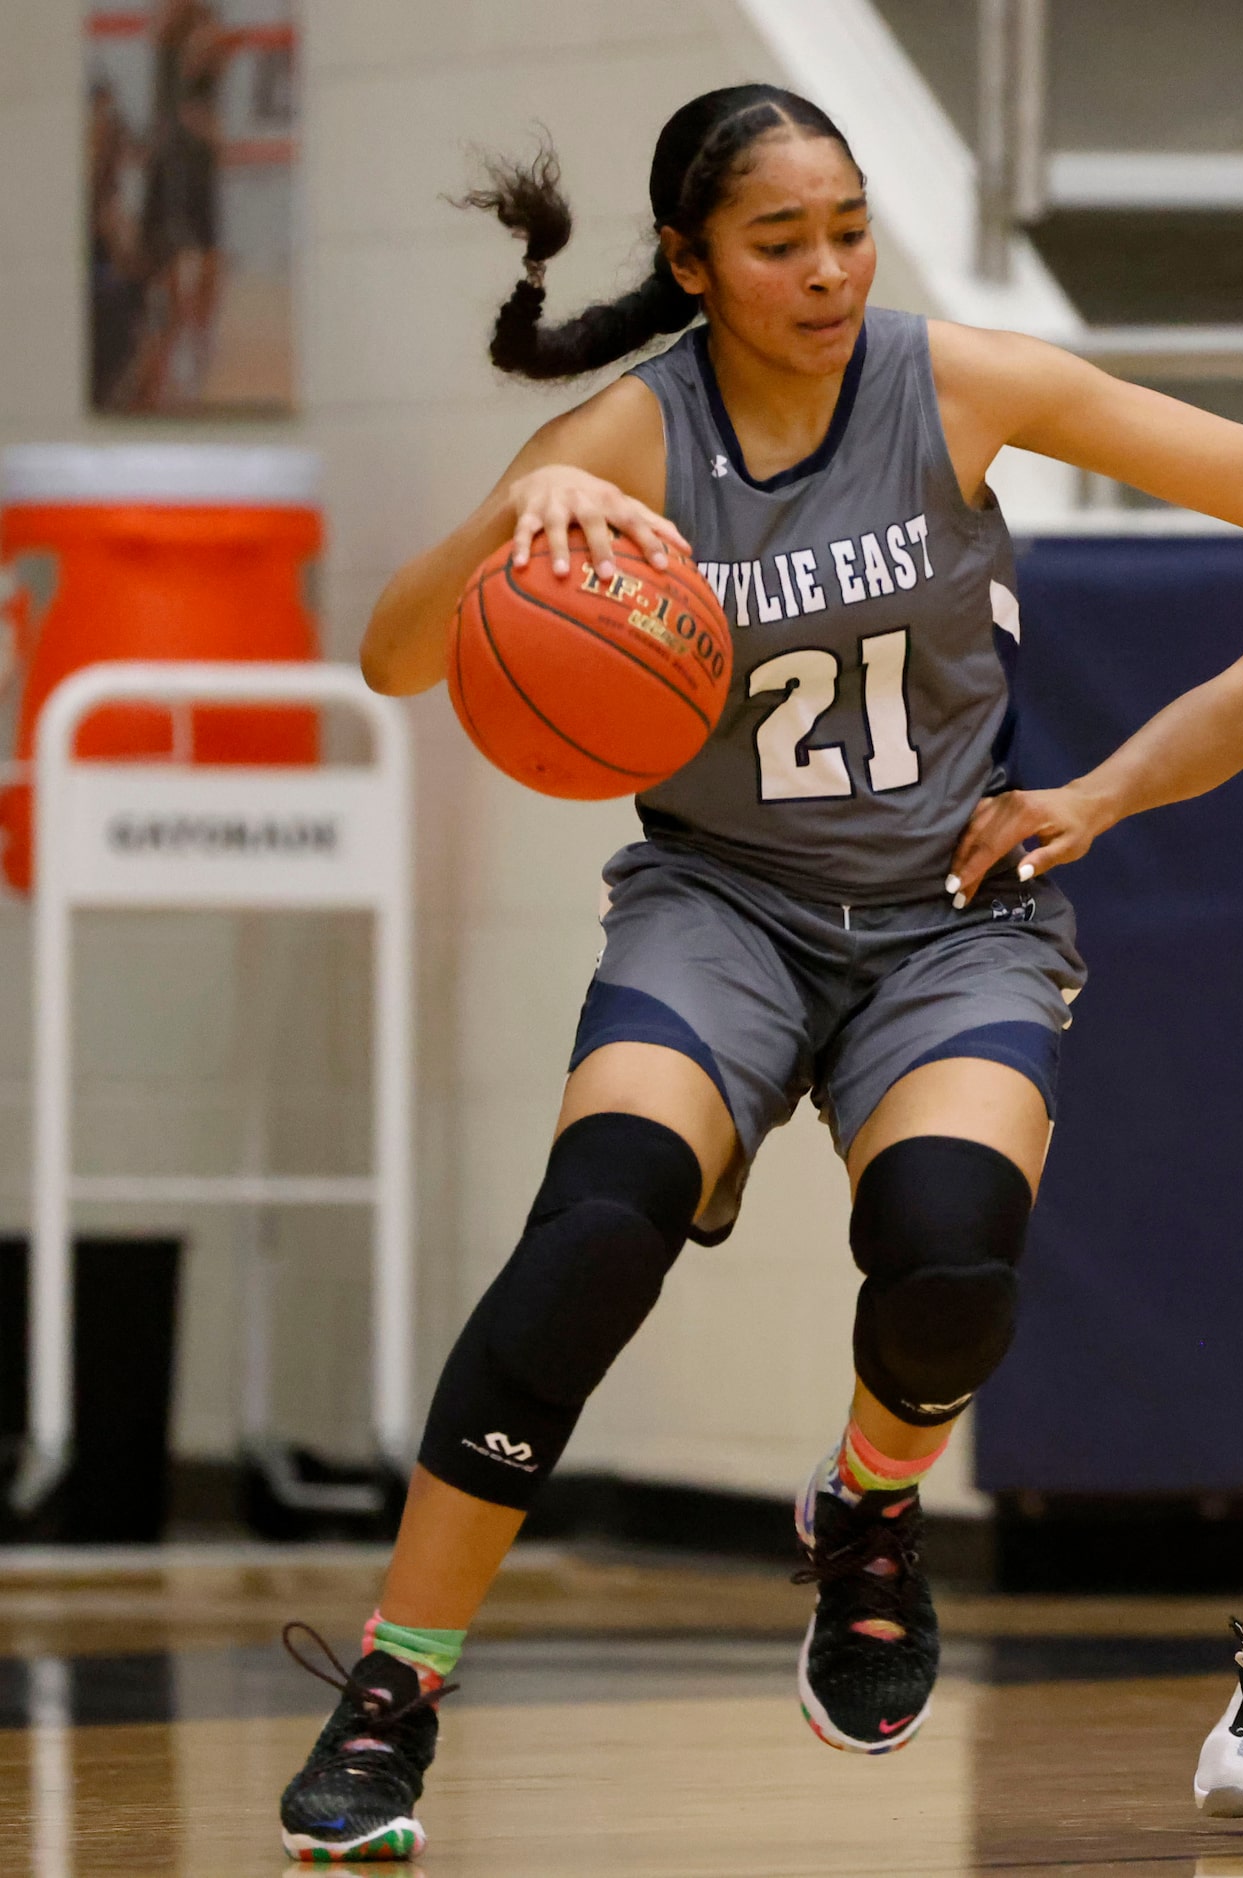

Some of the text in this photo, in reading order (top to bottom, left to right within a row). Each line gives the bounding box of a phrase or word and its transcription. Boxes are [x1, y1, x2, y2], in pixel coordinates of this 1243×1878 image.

[696, 513, 935, 628] WYLIE EAST
[747, 626, 922, 802] 21
